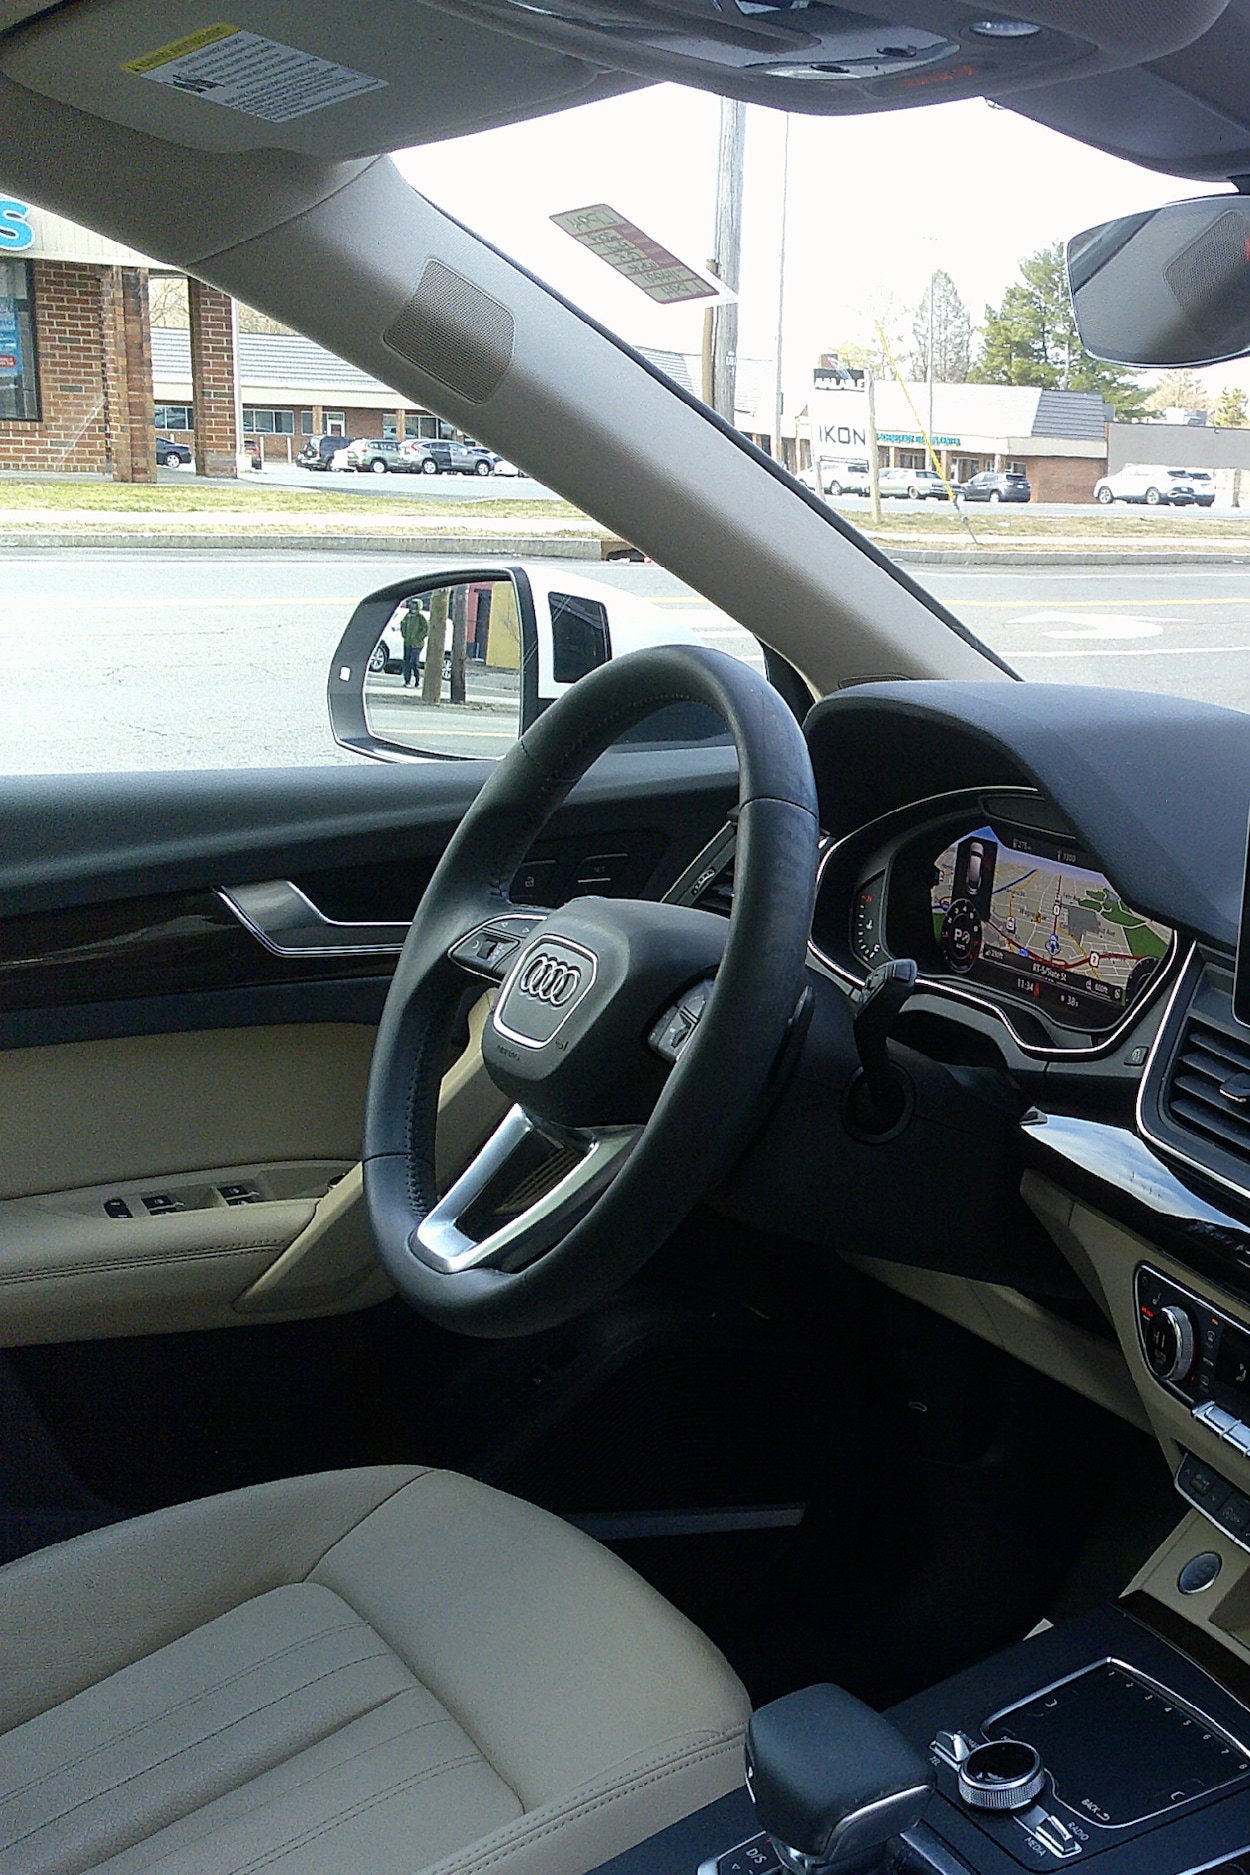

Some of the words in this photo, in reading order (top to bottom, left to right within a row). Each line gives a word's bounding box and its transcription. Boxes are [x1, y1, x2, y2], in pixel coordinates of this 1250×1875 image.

[819, 425, 866, 445] IKON
[1017, 978, 1034, 992] 11:34
[1080, 1798, 1100, 1815] BACK
[1066, 1821, 1090, 1841] RADIO
[745, 1847, 768, 1864] D/S
[1025, 1836, 1046, 1857] MEDIA
